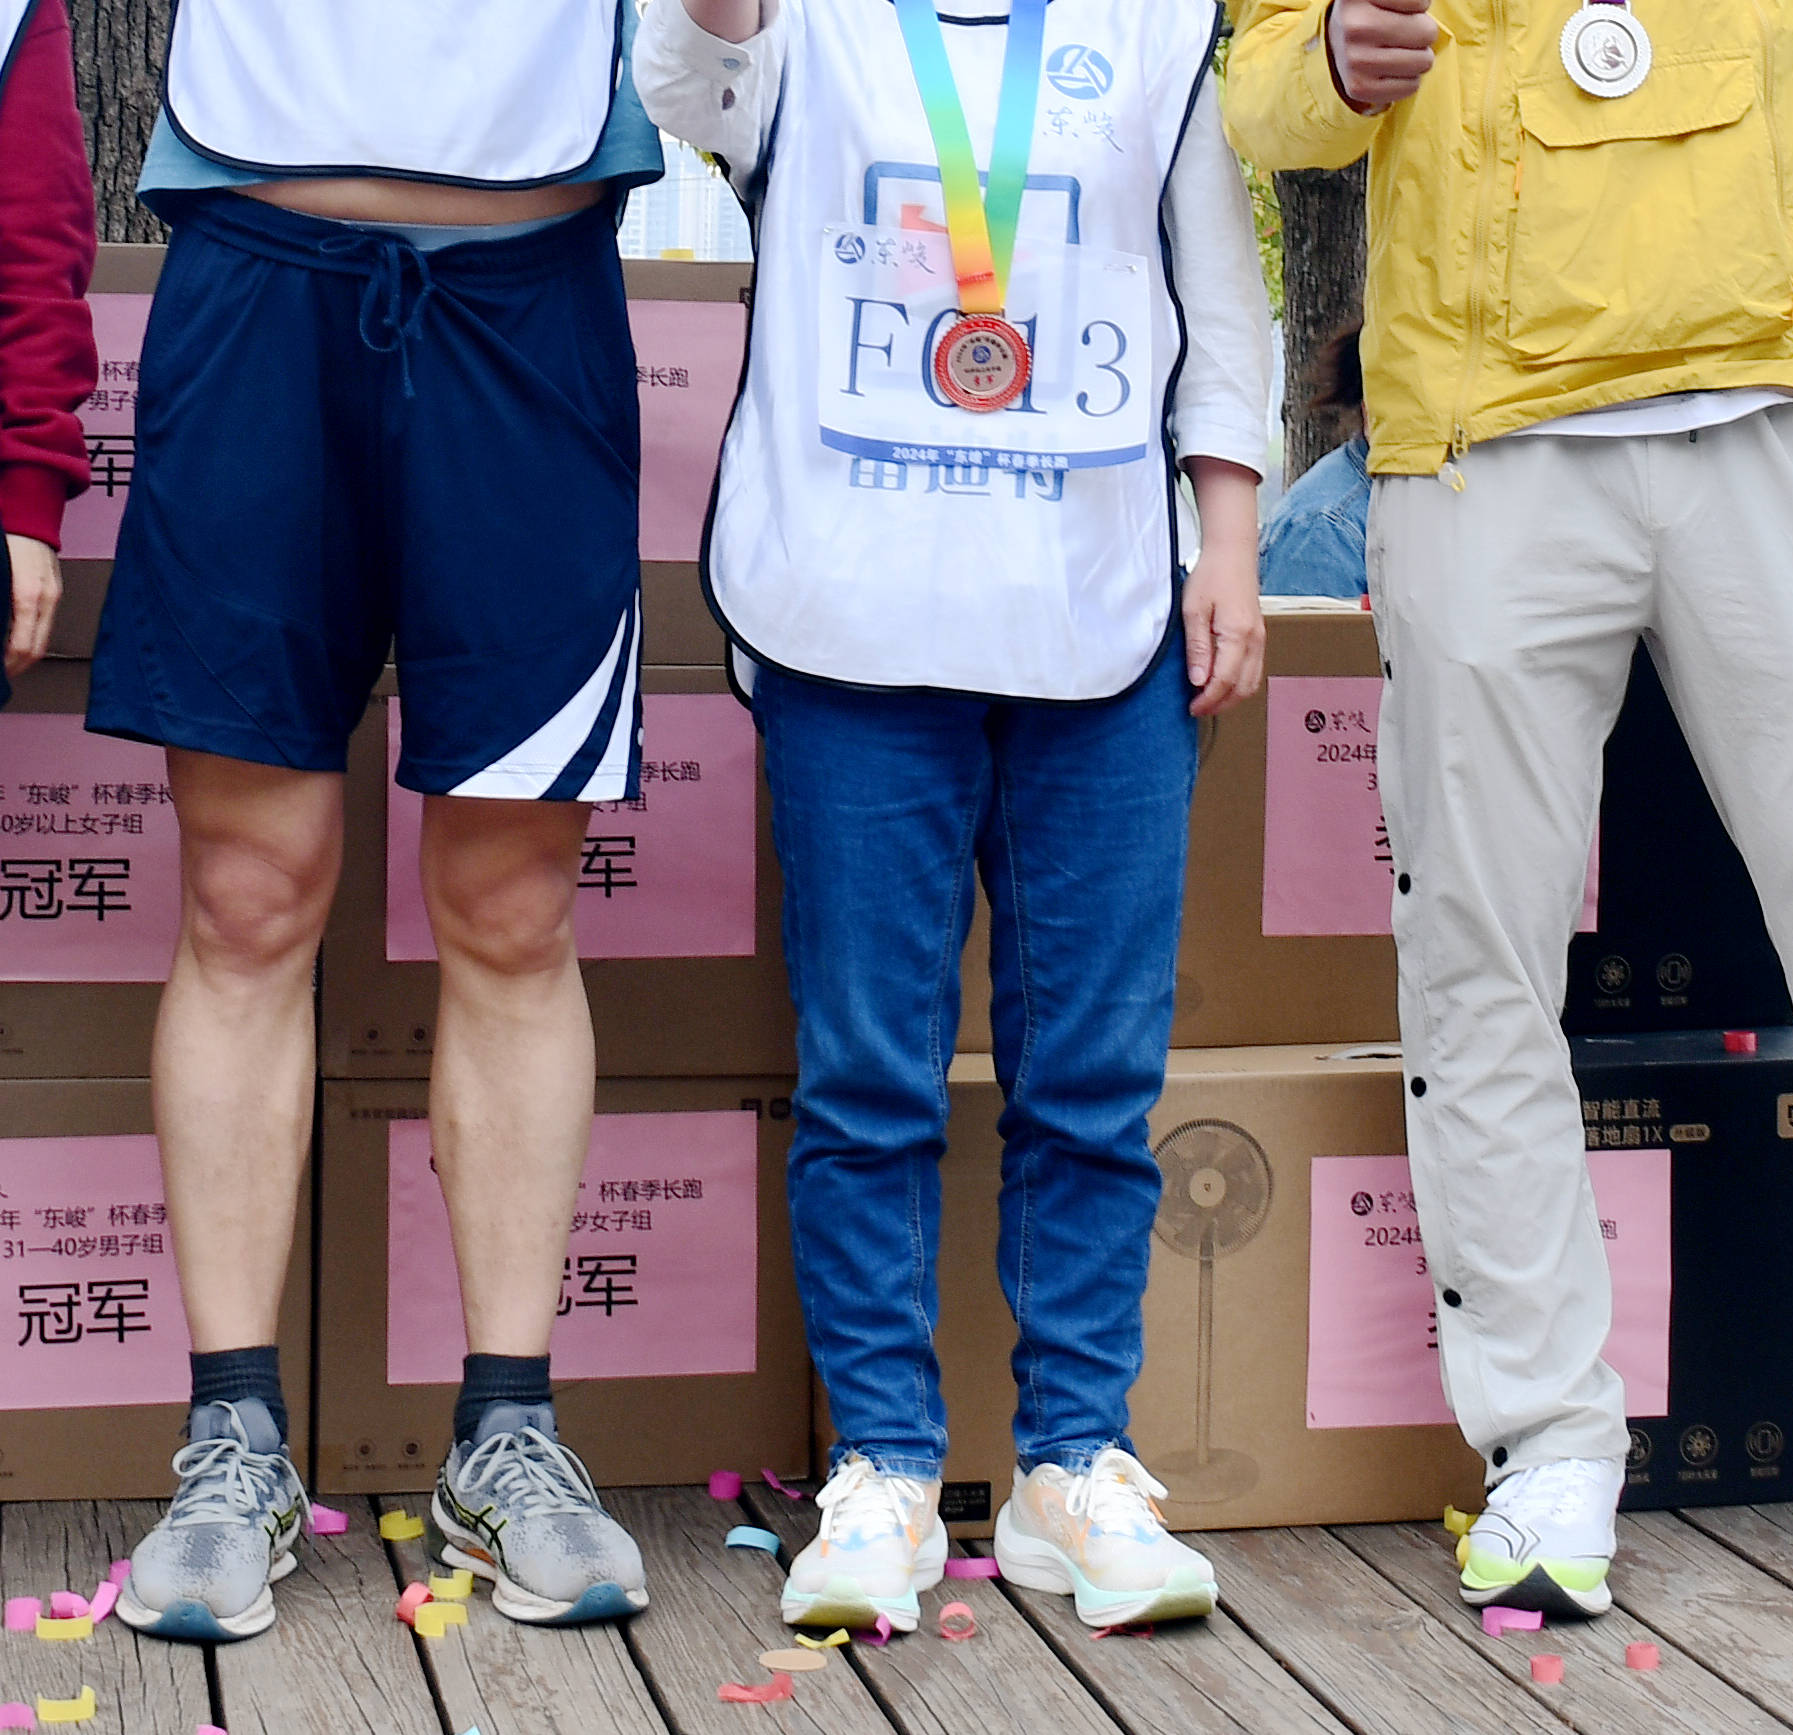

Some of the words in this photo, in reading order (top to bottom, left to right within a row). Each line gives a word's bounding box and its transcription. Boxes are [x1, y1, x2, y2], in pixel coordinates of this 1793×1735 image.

[576, 835, 638, 898] 军
[17, 1278, 152, 1347] 冠军
[556, 1254, 639, 1317] 军
